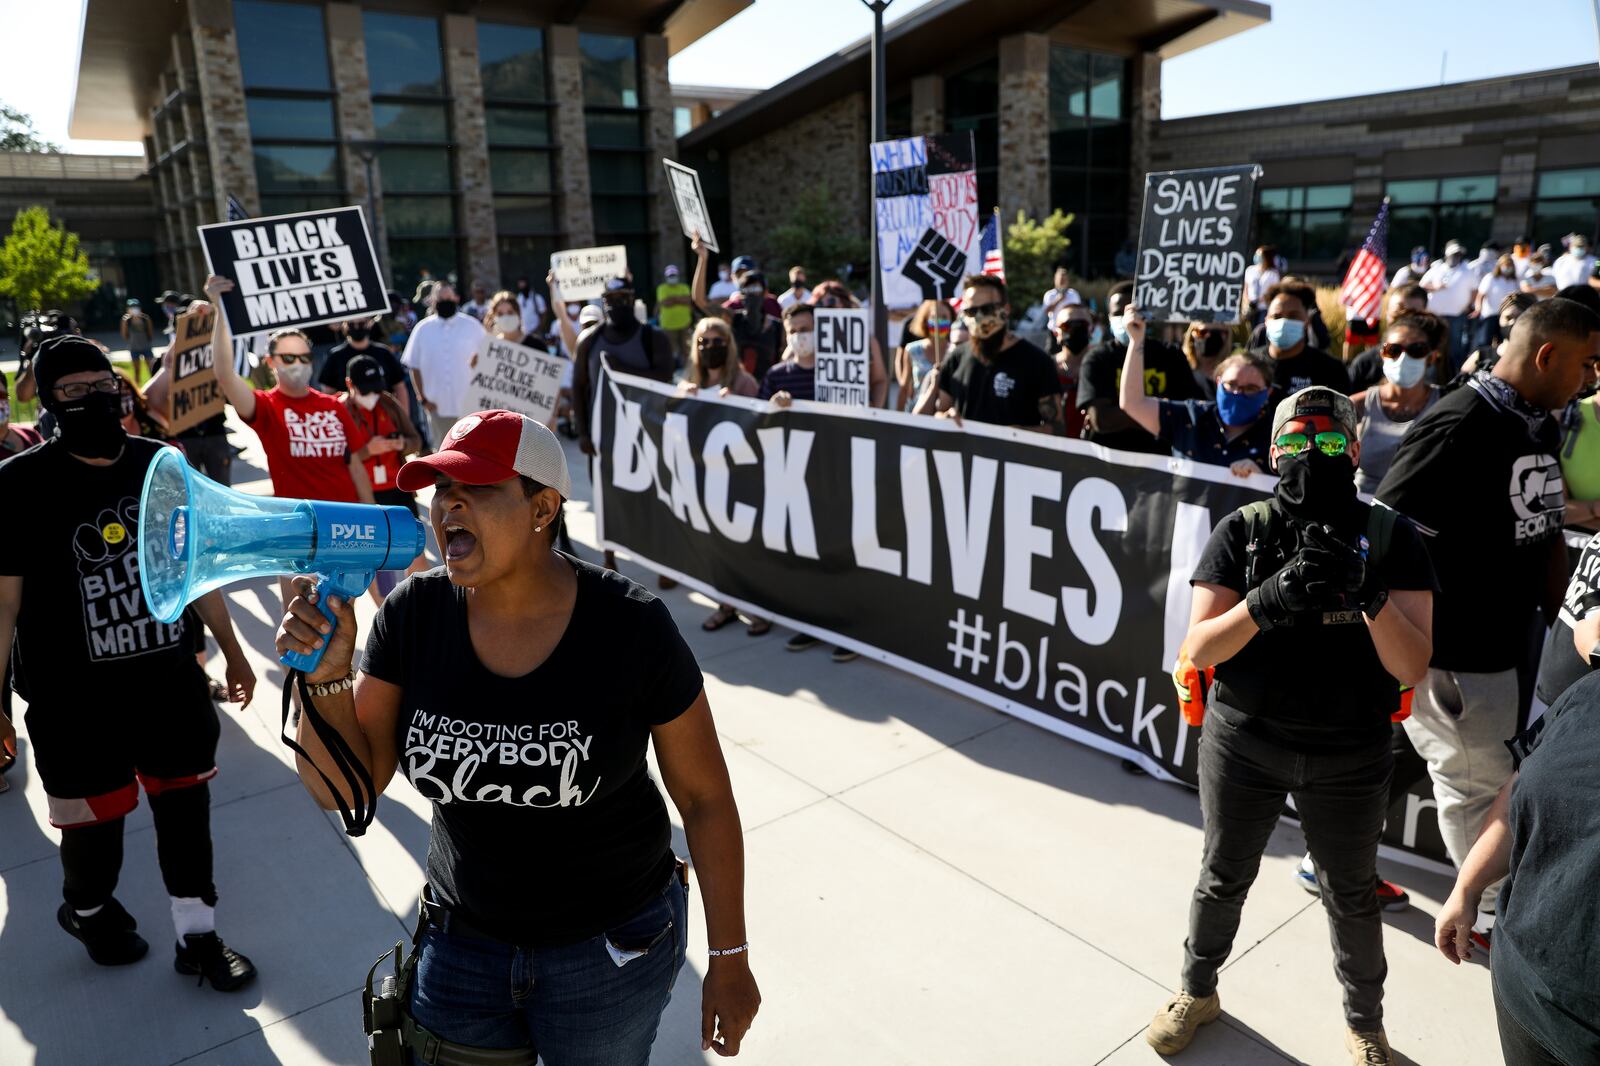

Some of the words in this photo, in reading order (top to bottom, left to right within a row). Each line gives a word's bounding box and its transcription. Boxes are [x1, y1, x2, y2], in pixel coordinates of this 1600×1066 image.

[1153, 175, 1240, 216] SAVE
[231, 217, 344, 260] BLACK
[1159, 216, 1233, 247] LIVES
[251, 252, 341, 290] LIVES
[1138, 248, 1246, 280] DEFUND
[244, 280, 367, 327] MATTER
[1137, 281, 1169, 308] The
[1168, 275, 1242, 313] POLICE
[817, 316, 865, 355] END
[487, 342, 530, 367] HOLD
[534, 356, 562, 379] THE
[496, 362, 534, 388] POLICE
[817, 358, 865, 385] POLICE
[470, 372, 554, 411] ACCOUNTABLE
[289, 423, 345, 439] LIVES
[331, 523, 375, 540] PYLE
[612, 400, 820, 561] BLACK
[851, 436, 1128, 646] LIVES
[412, 709, 436, 730] I'M
[437, 716, 533, 741] ROOTING
[539, 720, 581, 741] FOR
[405, 726, 593, 766] EVERYBODY
[405, 746, 601, 808] Black
